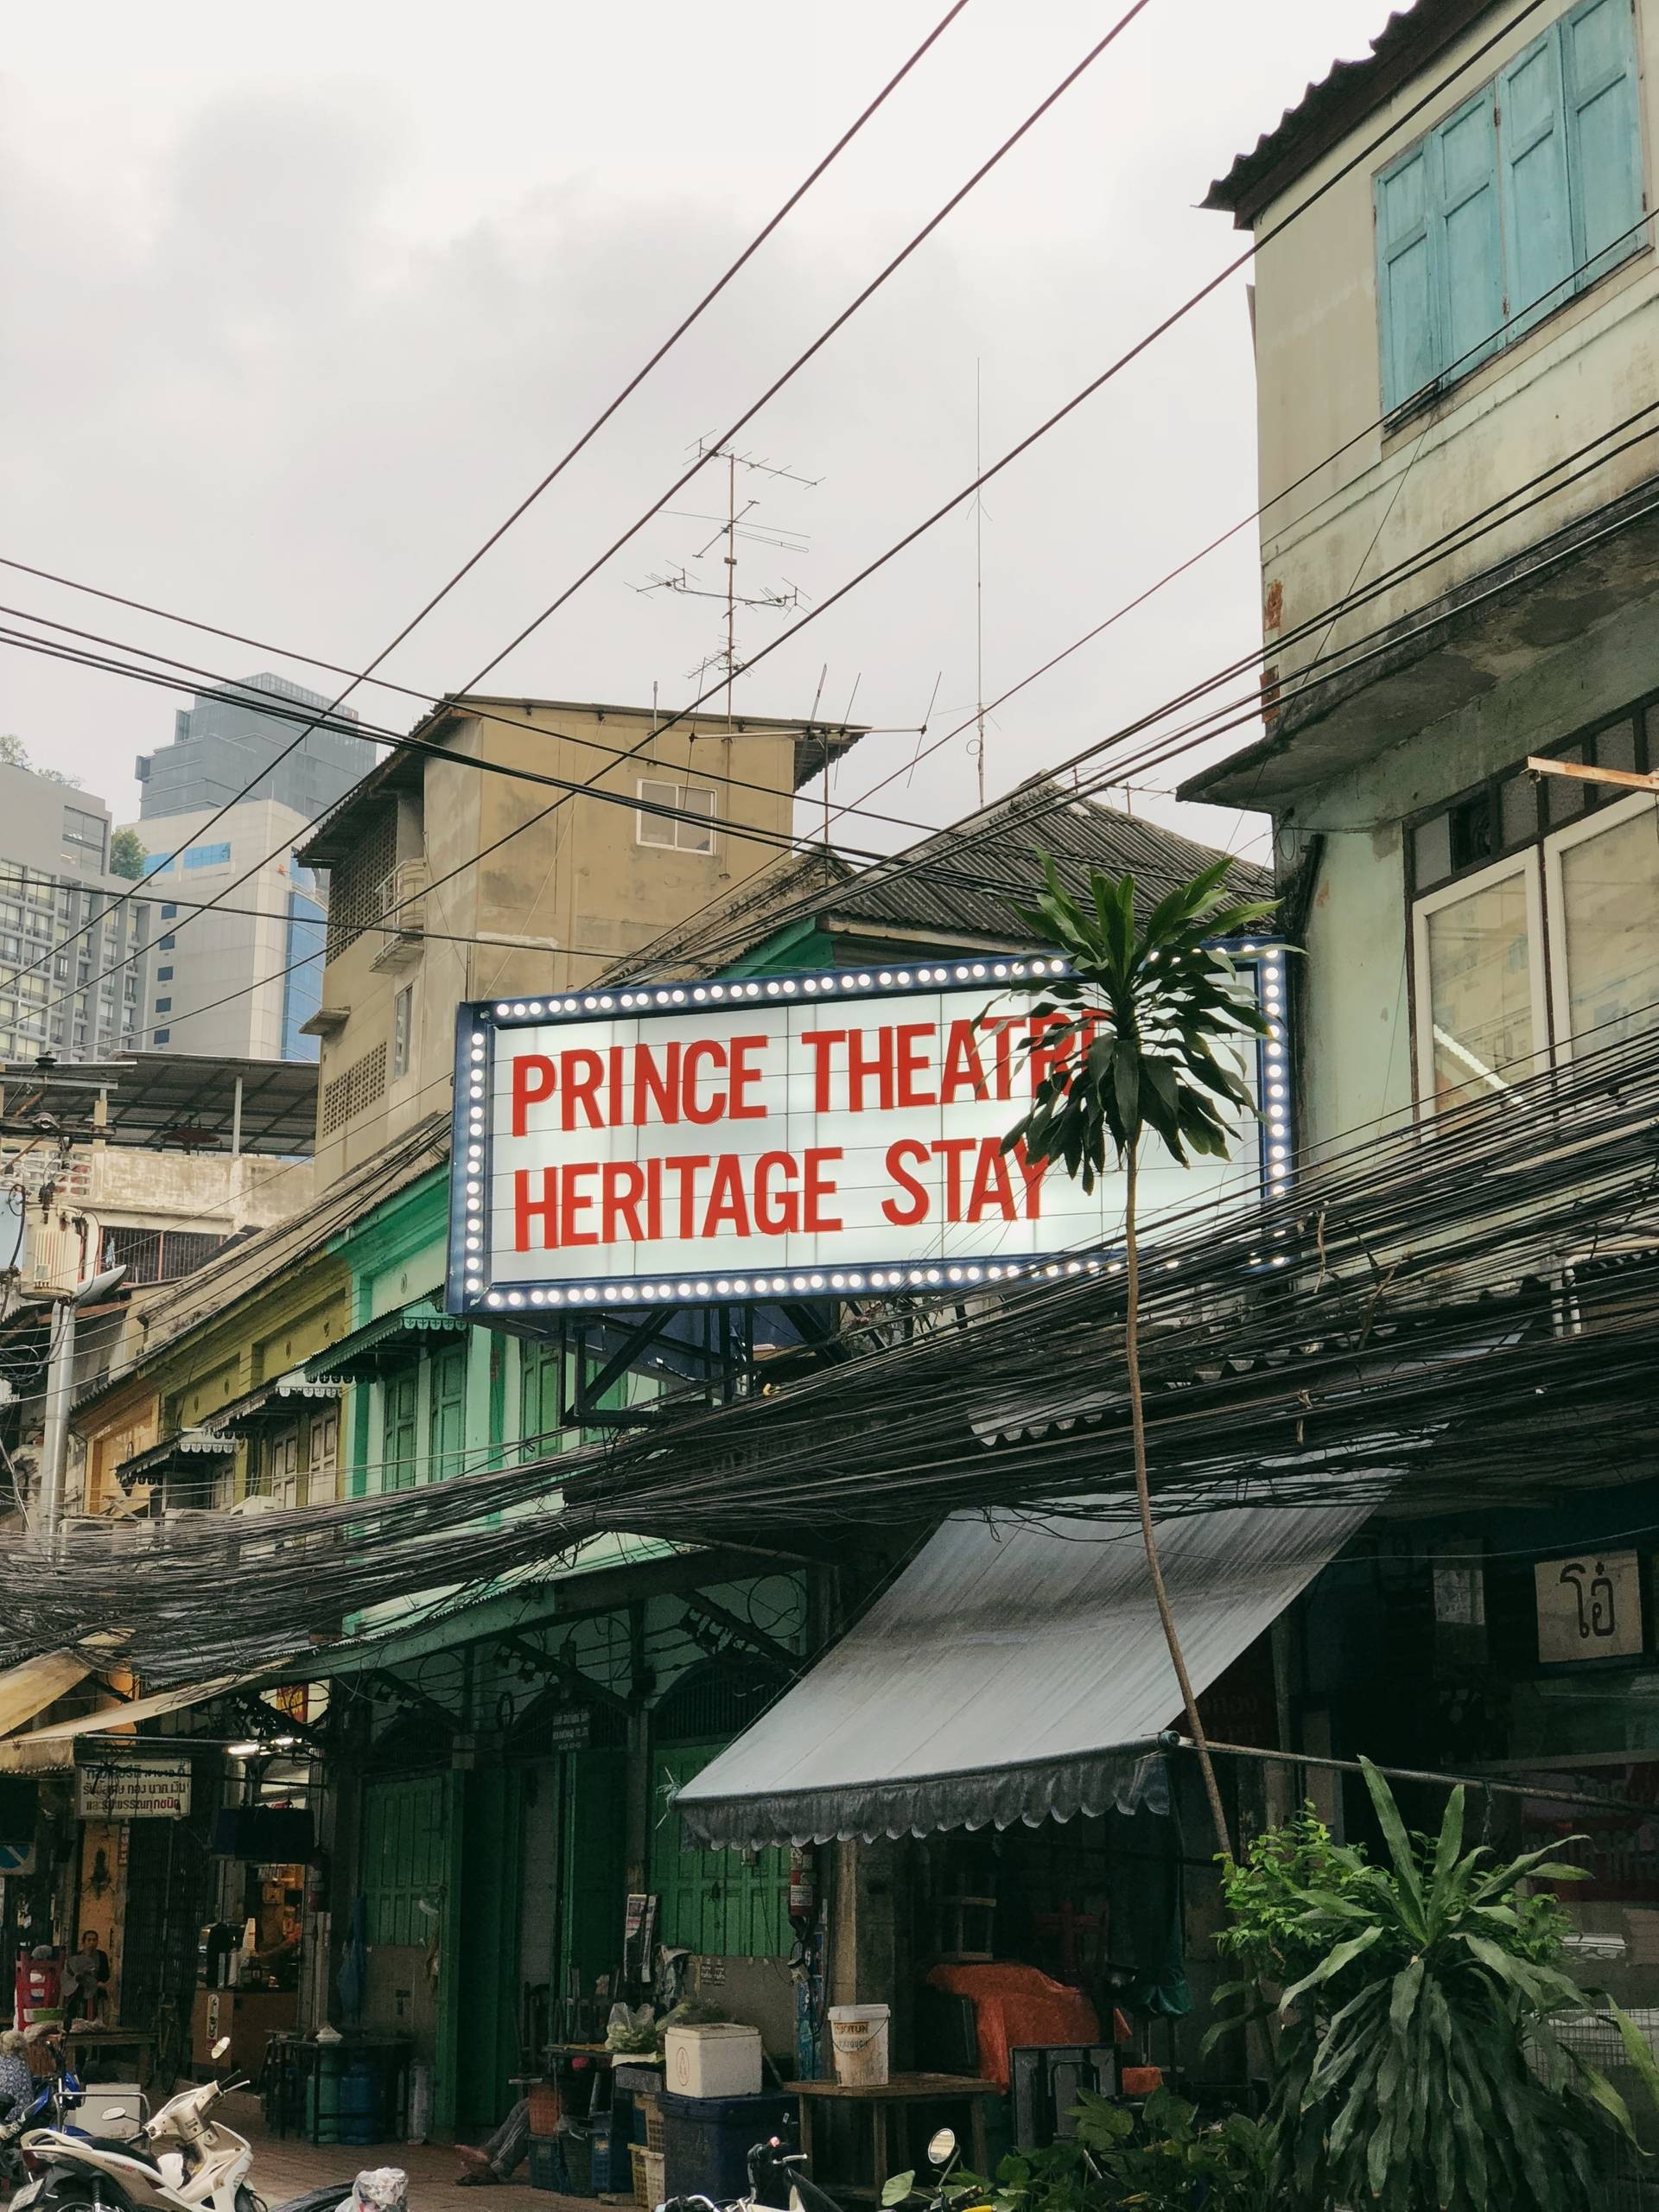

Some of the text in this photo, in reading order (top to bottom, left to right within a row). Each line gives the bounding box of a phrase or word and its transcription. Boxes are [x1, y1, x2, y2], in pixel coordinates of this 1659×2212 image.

[512, 1034, 769, 1137] PRINCE
[513, 1136, 1051, 1253] HERITAGE STAY
